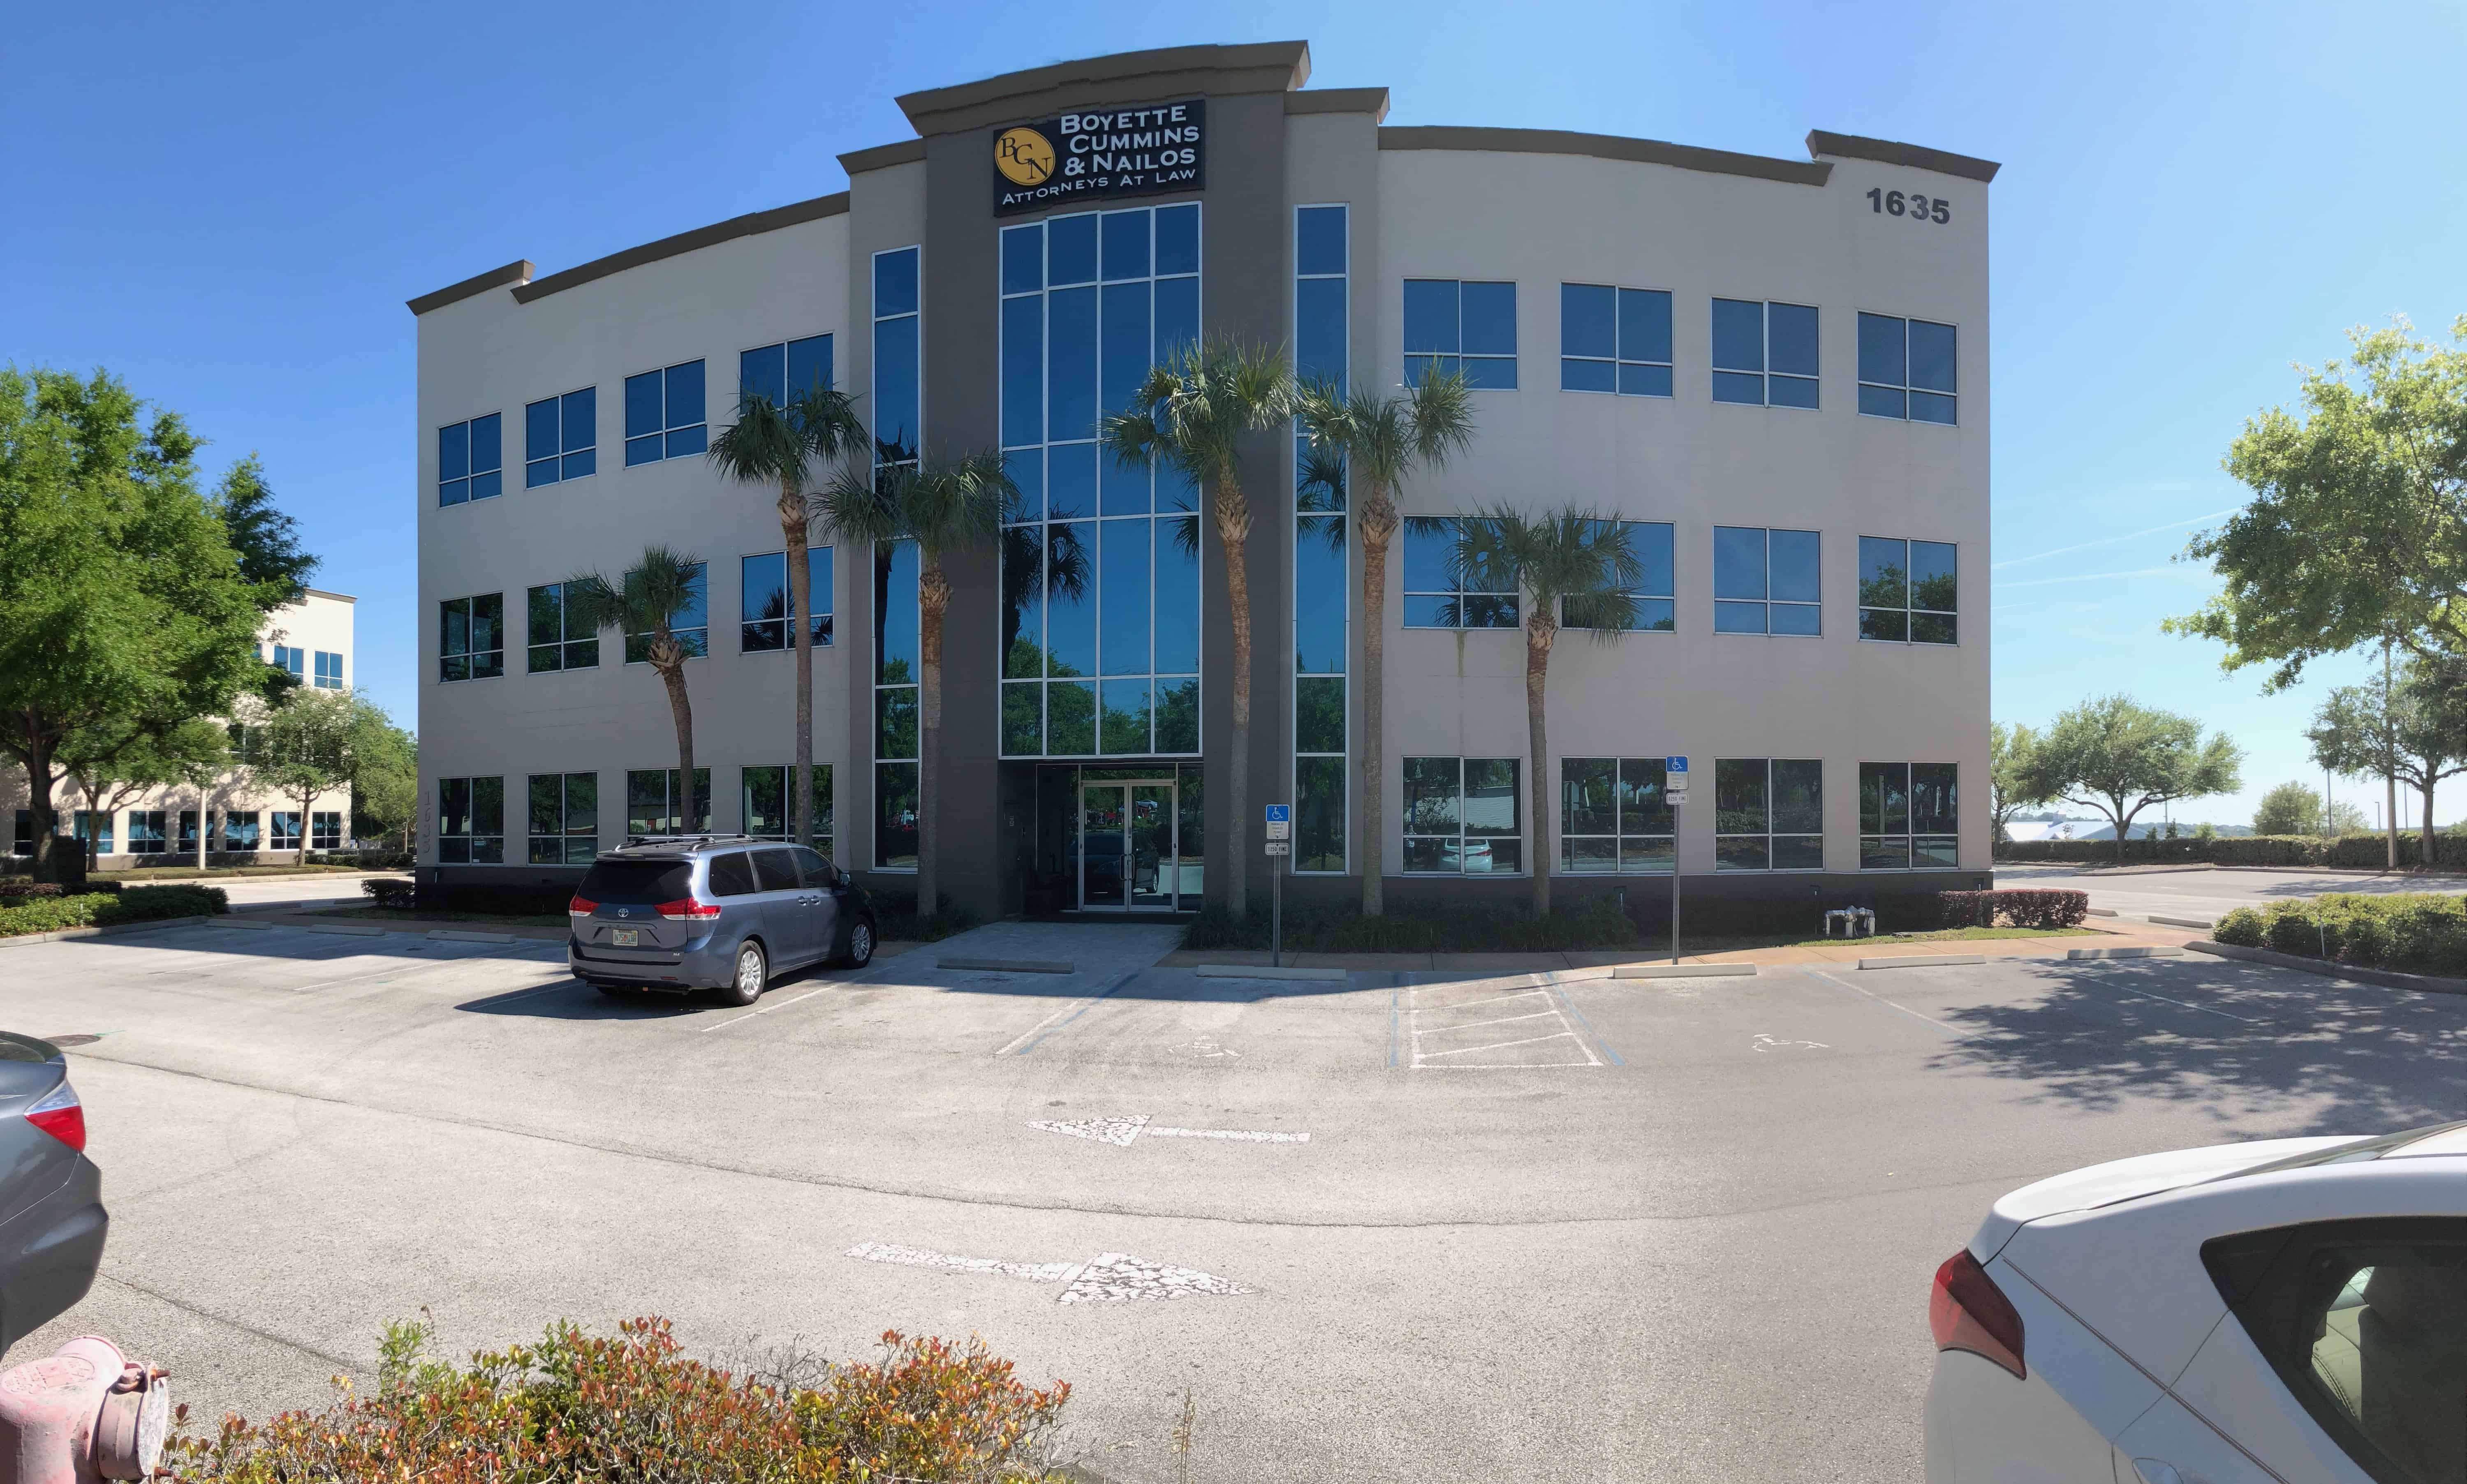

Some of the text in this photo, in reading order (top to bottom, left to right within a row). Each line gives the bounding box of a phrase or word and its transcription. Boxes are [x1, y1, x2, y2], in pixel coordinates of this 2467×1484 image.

[1061, 105, 1187, 134] BOYETTE
[1069, 126, 1199, 154] CUMMINS
[1065, 148, 1196, 176] & NAILOS
[1002, 169, 1196, 205] ATTORNEYS AT LAW
[1867, 187, 1950, 224] 1635
